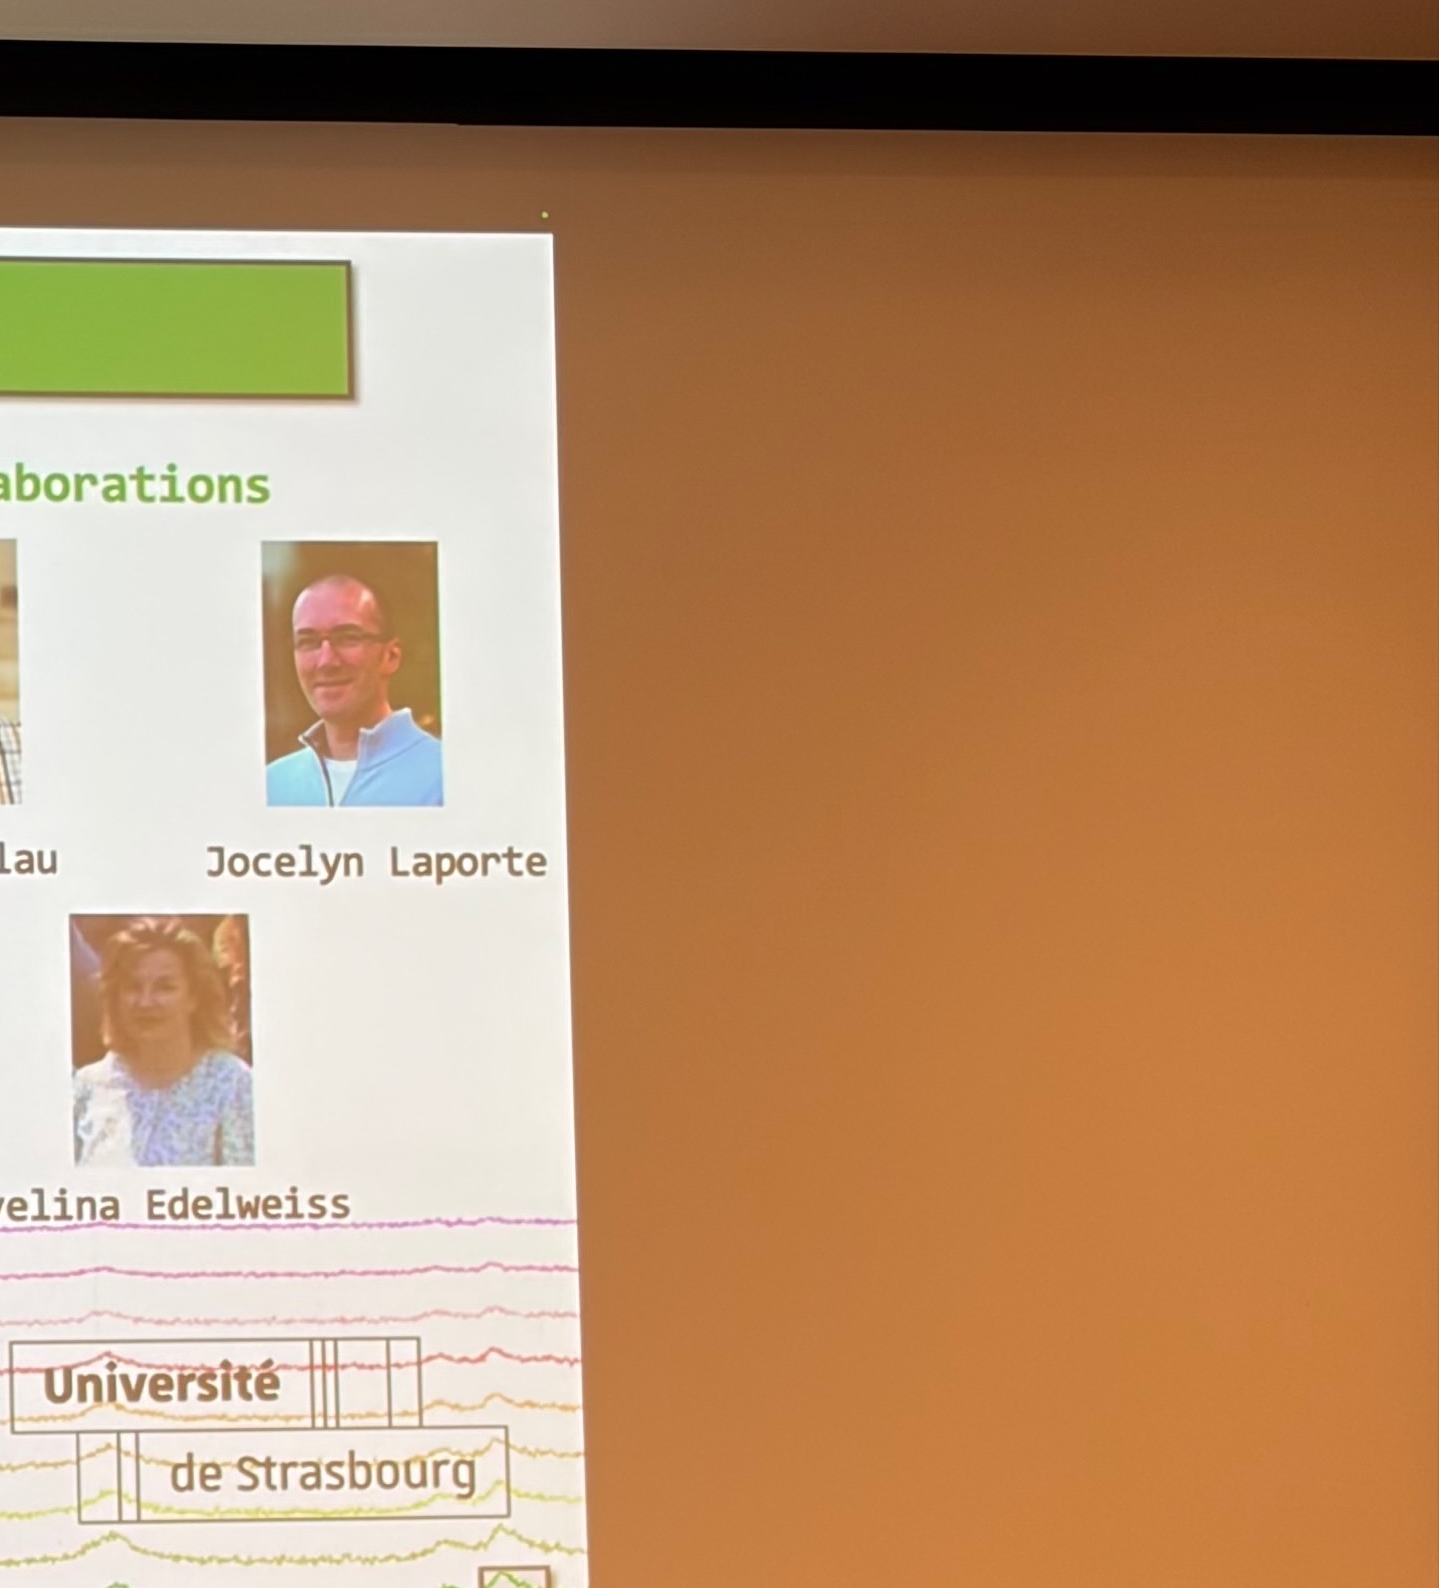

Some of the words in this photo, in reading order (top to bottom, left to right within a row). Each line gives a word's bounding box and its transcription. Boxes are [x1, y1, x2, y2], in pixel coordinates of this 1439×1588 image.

[207, 844, 364, 886] Jocelyn
[391, 846, 547, 885] Laporte
[147, 1186, 350, 1220] Edelweiss
[43, 1357, 281, 1404] Université
[171, 1452, 222, 1492] de
[236, 1451, 476, 1498] Strasbourg
